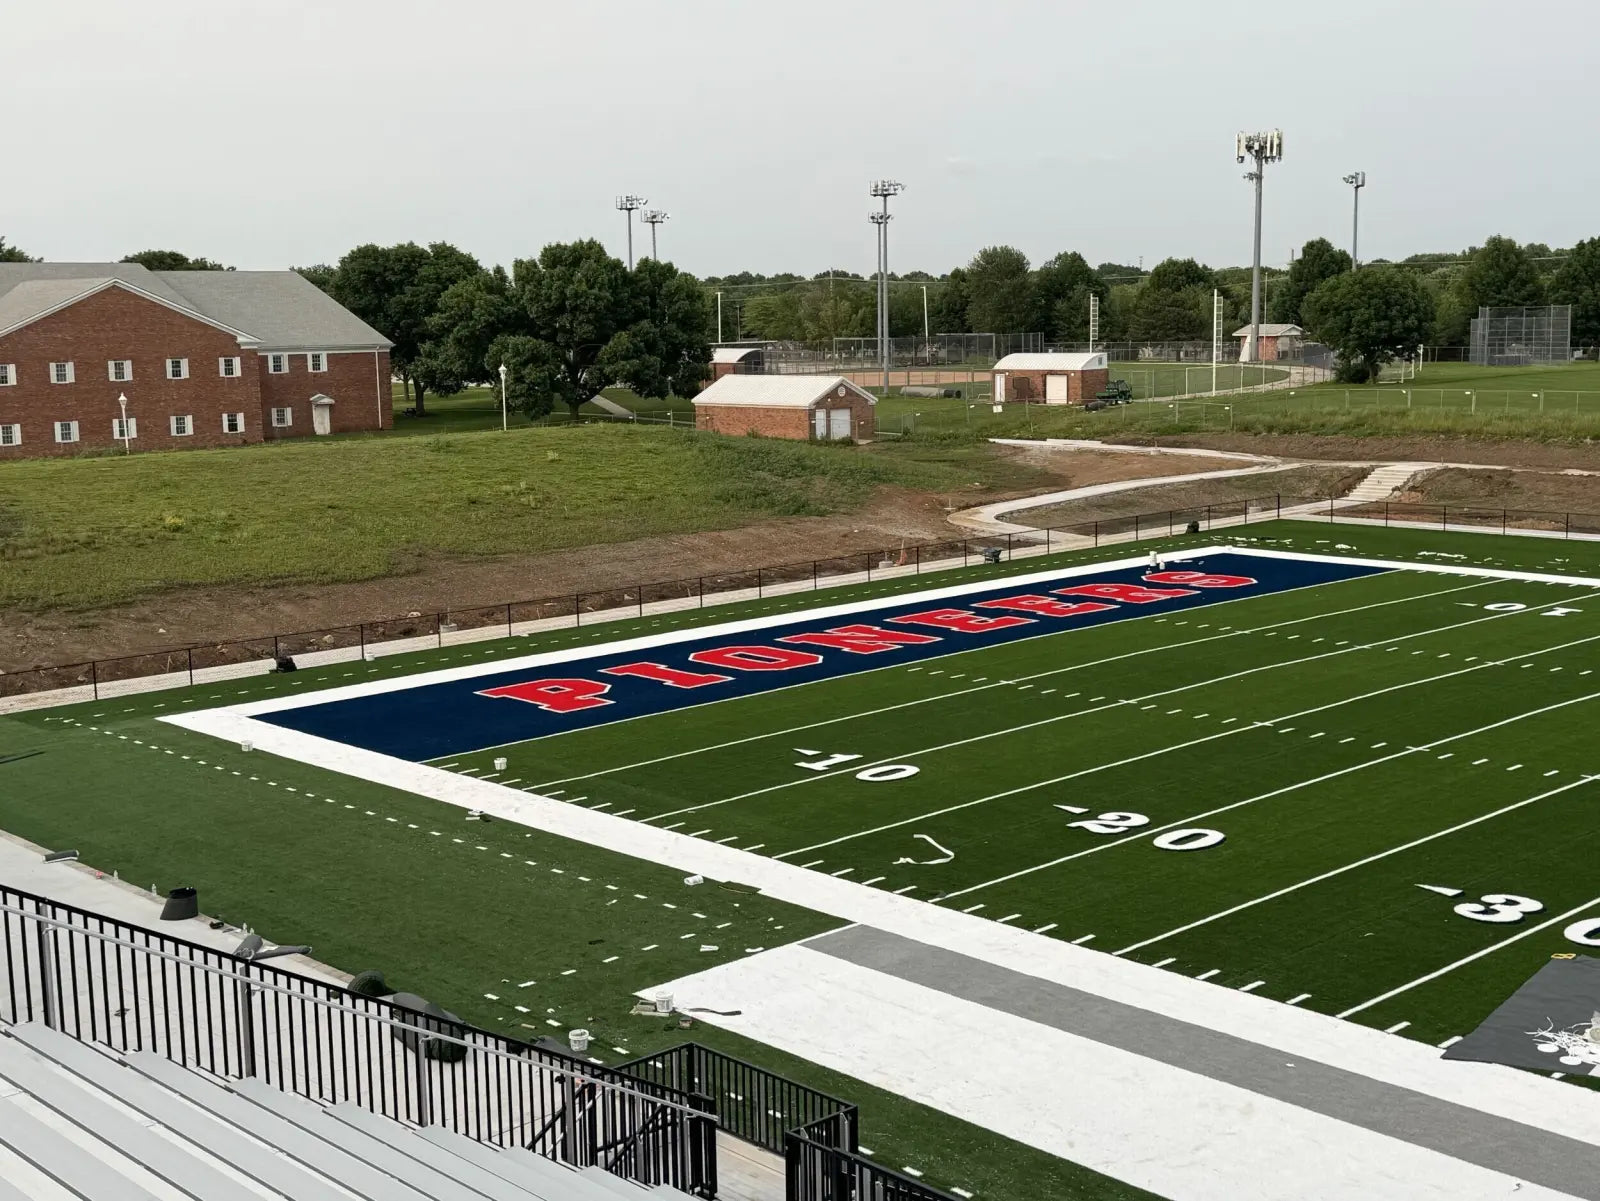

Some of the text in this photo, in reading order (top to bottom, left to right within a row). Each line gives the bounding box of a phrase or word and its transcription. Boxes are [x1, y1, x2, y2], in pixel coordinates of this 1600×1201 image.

[1483, 602, 1583, 617] 10
[473, 570, 1259, 714] PIONEERS
[794, 754, 921, 782] 10
[1066, 812, 1226, 851] 20
